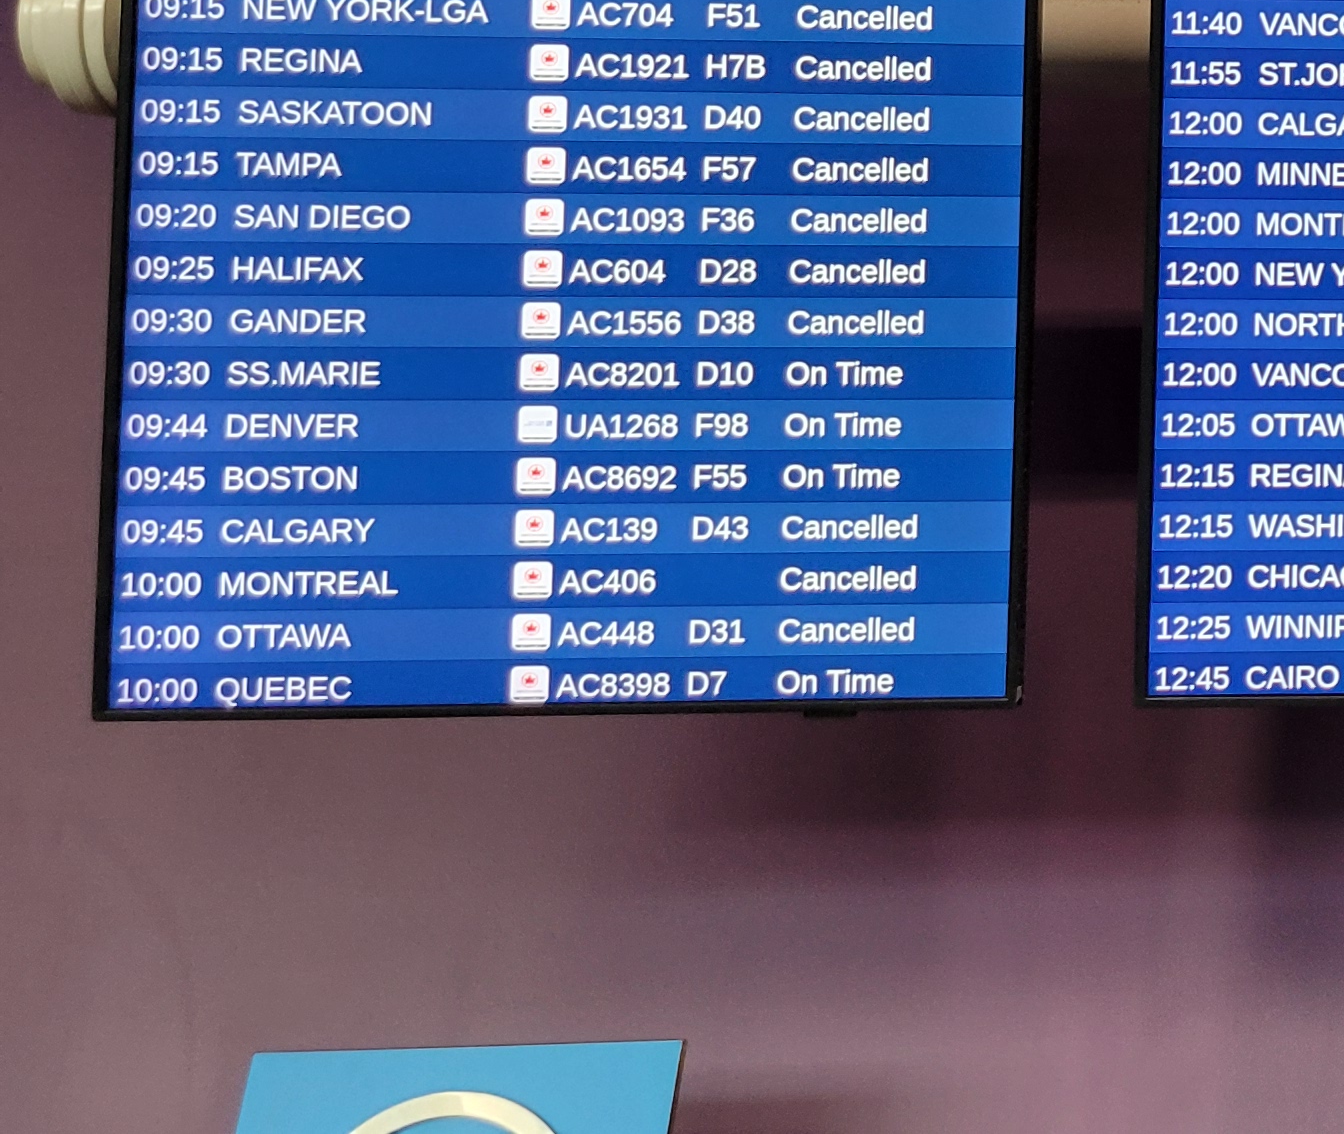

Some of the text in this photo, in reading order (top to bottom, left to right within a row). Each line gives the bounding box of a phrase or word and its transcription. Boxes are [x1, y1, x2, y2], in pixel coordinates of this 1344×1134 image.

[143, 47, 931, 81] 09:15 REGINA AC1921 H7B Cancelled
[1171, 61, 1241, 85] 11:55
[126, 412, 901, 439] 09:44 DENVER UA1268 F98 On Time
[1162, 413, 1235, 437] 12:05
[122, 565, 916, 598] 10:00 MONTREAL AC406 Cancelled
[1156, 666, 1229, 691] 12:45
[1246, 665, 1339, 690] CAIRO
